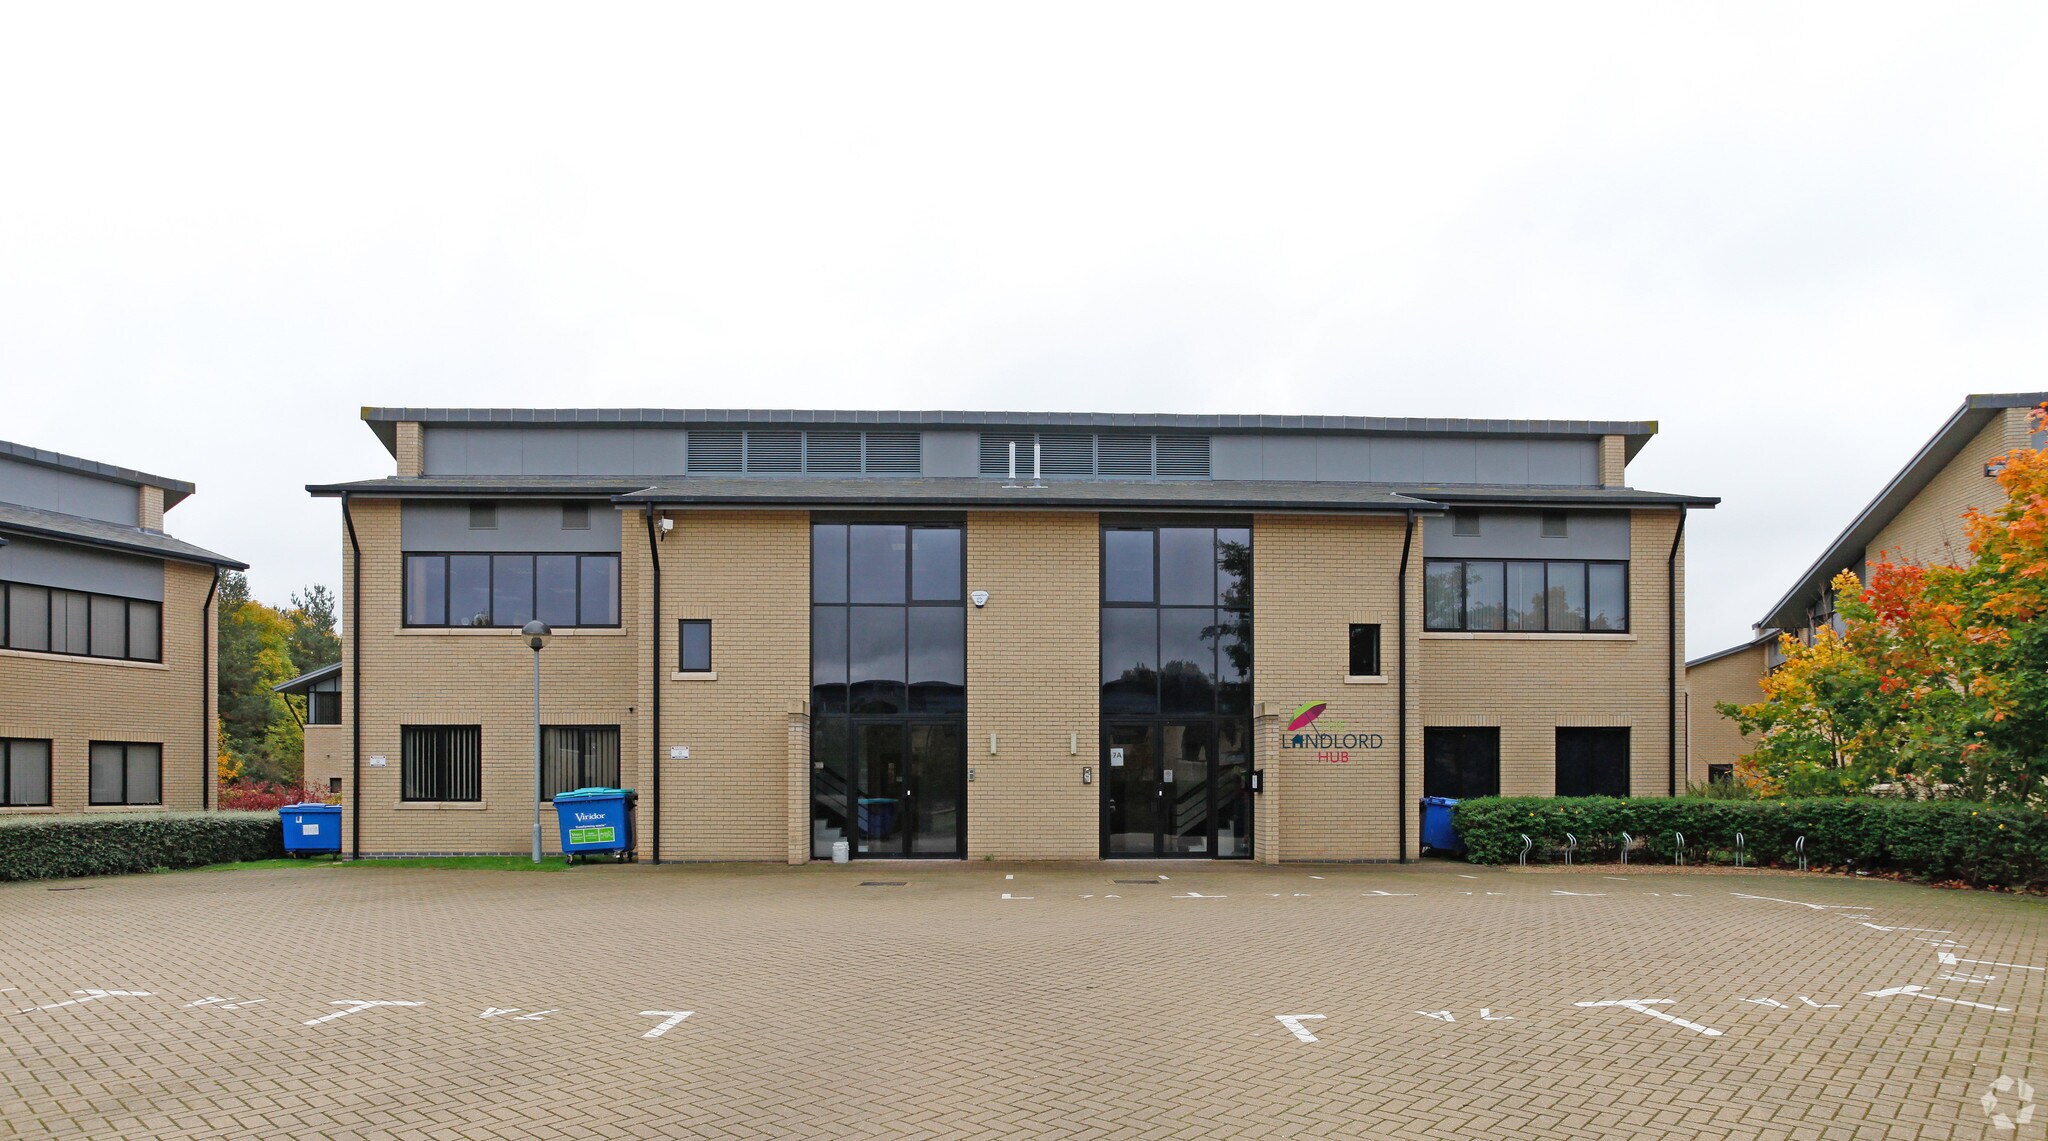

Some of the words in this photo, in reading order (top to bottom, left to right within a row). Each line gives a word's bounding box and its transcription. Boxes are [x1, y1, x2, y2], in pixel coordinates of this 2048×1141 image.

[1319, 720, 1345, 731] THE
[1282, 734, 1383, 749] LANDLORD
[1318, 751, 1349, 763] HUB
[575, 812, 605, 822] Viridor
